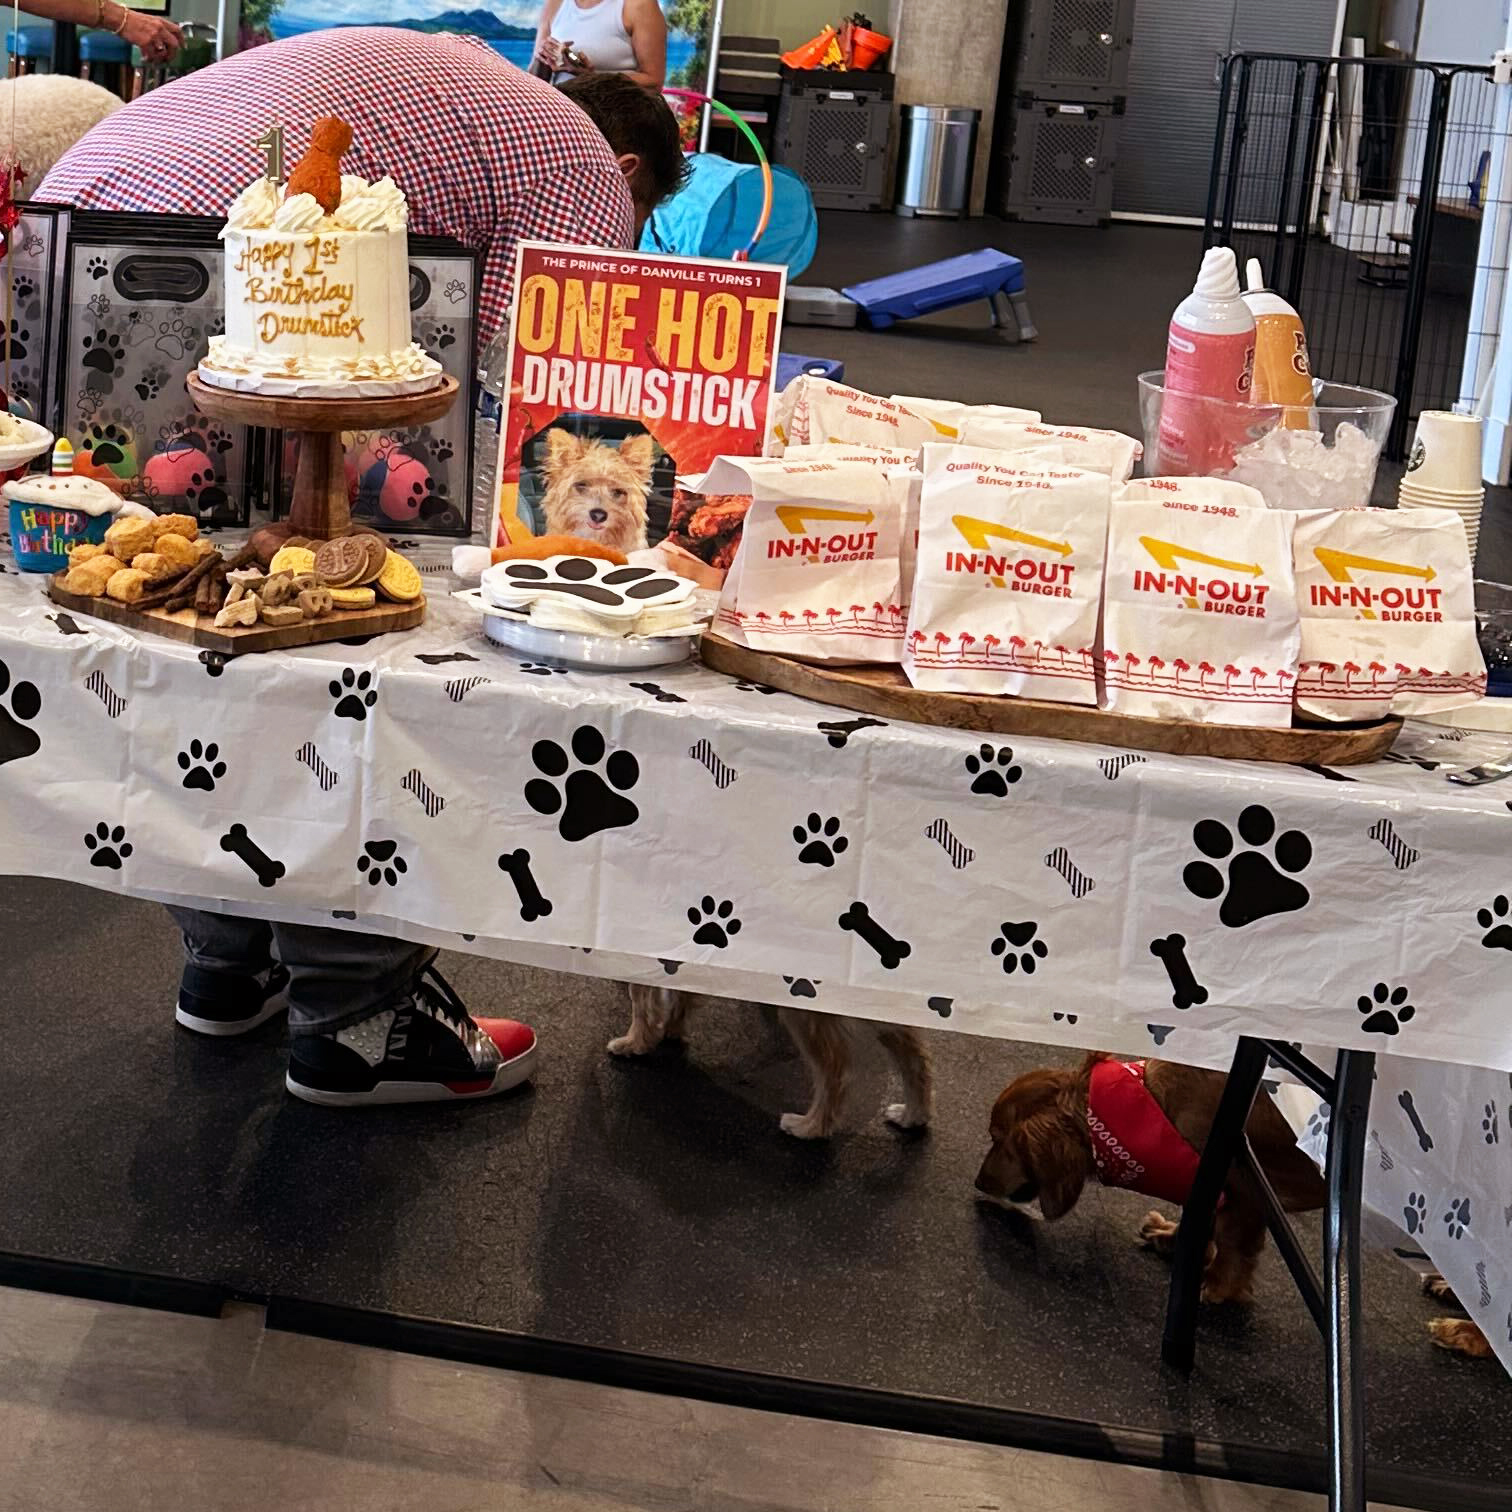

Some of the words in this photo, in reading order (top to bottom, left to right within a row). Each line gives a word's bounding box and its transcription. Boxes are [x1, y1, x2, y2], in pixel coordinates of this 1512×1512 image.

[234, 236, 295, 278] Happy
[303, 236, 341, 276] 1st
[542, 256, 567, 268] THE
[570, 259, 617, 274] PRINCE
[620, 263, 639, 275] OF
[641, 266, 705, 282] DANVILLE
[708, 272, 753, 286] TURNS
[755, 276, 761, 287] 1
[244, 277, 354, 314] Birthday
[258, 308, 365, 343] Drumstick
[518, 274, 641, 362] ONE
[654, 288, 778, 376] HOT
[521, 354, 761, 431] DRUMSTICK
[826, 385, 860, 401] Quality
[862, 394, 878, 405] You
[846, 405, 873, 419] Since
[880, 456, 900, 464] You
[946, 462, 991, 472] Quality
[994, 465, 1016, 476] You
[976, 475, 1012, 486] Since
[1202, 505, 1239, 517] 1948.
[767, 531, 879, 559] IN-N-OUT
[823, 551, 875, 564] BURGER
[945, 551, 1076, 585] IN-N-OUT
[1011, 580, 1073, 599] BURGER
[1133, 569, 1270, 605] IN-N-OUT
[1310, 585, 1443, 609] IN-N-OUT
[1204, 601, 1266, 619] BURGER
[1381, 610, 1443, 624] BURGER
